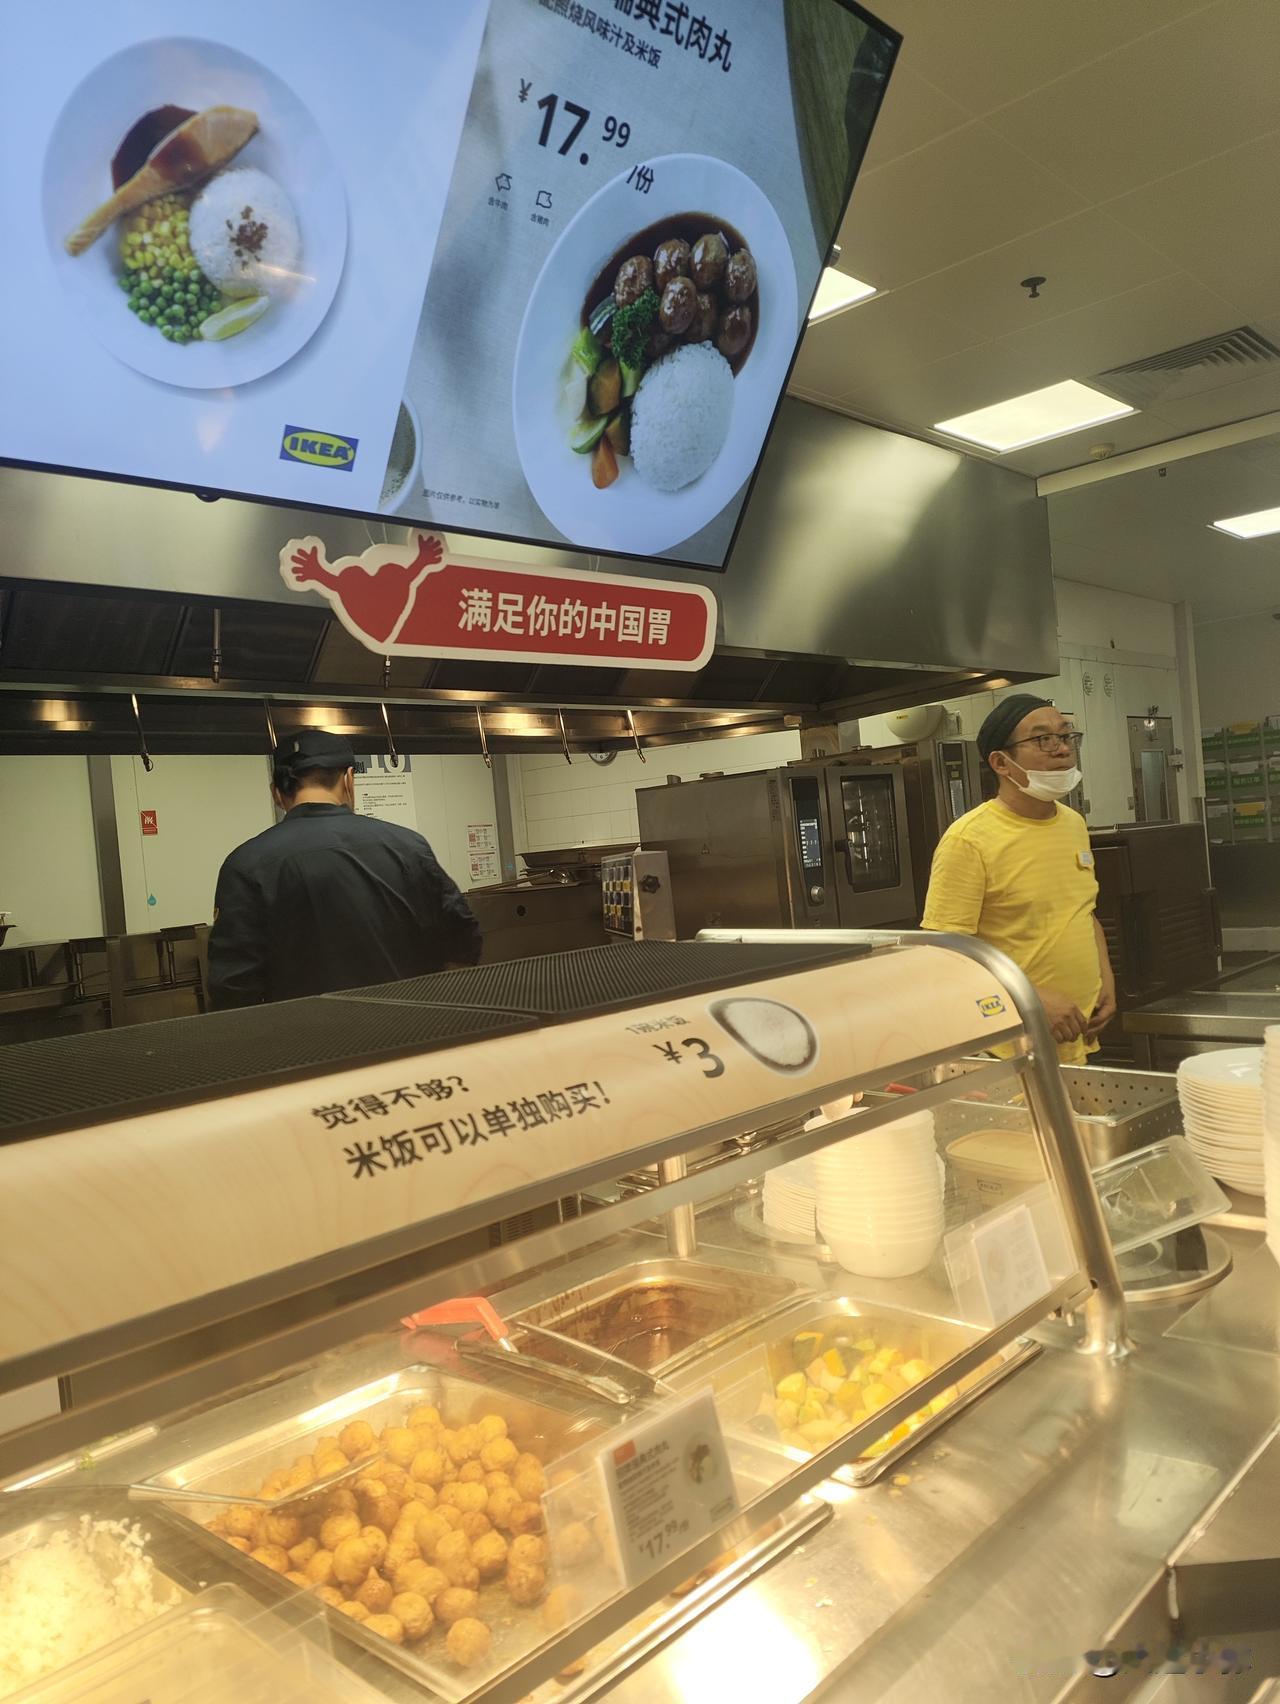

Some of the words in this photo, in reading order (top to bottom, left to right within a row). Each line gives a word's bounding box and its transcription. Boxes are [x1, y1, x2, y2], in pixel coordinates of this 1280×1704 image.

[289, 436, 350, 461] IKEA
[457, 587, 672, 646] 满足你的中国胃
[652, 1037, 725, 1079] ¥3
